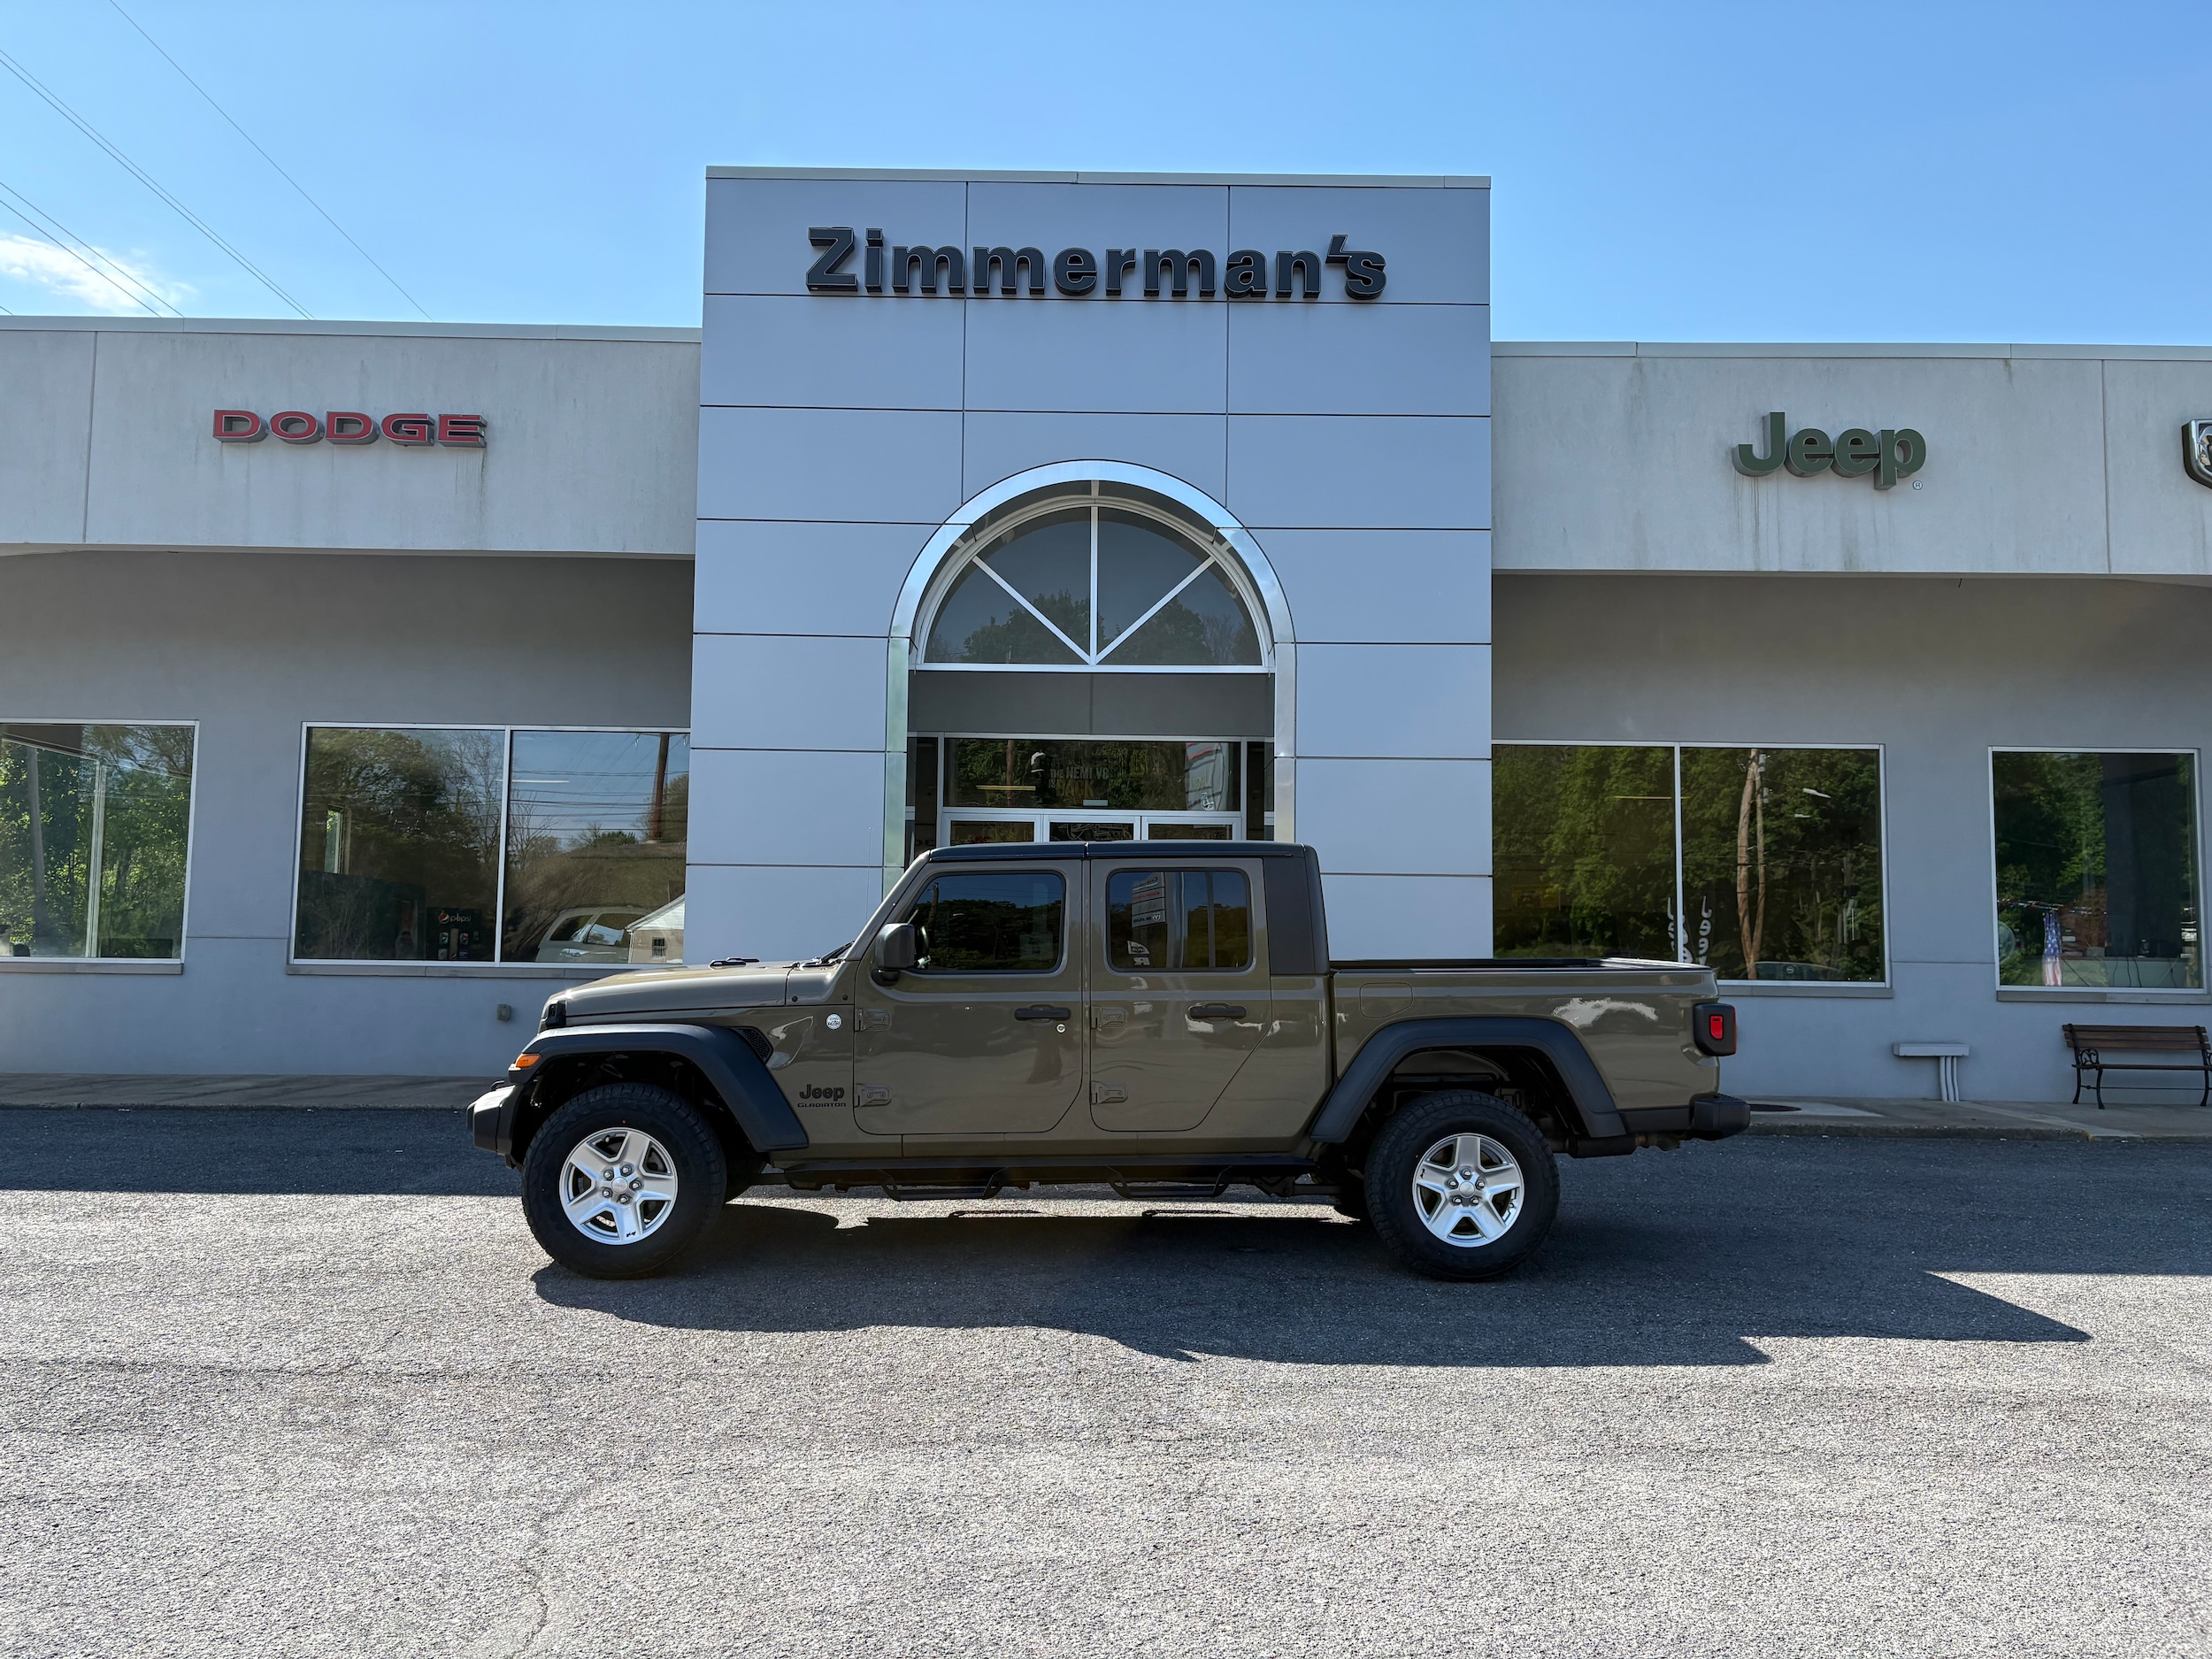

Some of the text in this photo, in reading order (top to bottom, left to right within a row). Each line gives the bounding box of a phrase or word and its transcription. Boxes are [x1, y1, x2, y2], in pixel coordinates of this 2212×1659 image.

[805, 227, 1386, 300] Zimmerman's
[213, 409, 488, 448] DODGE
[1732, 411, 1926, 490] Jeep
[1066, 766, 1093, 780] HEMI
[799, 1084, 845, 1102] Jeep
